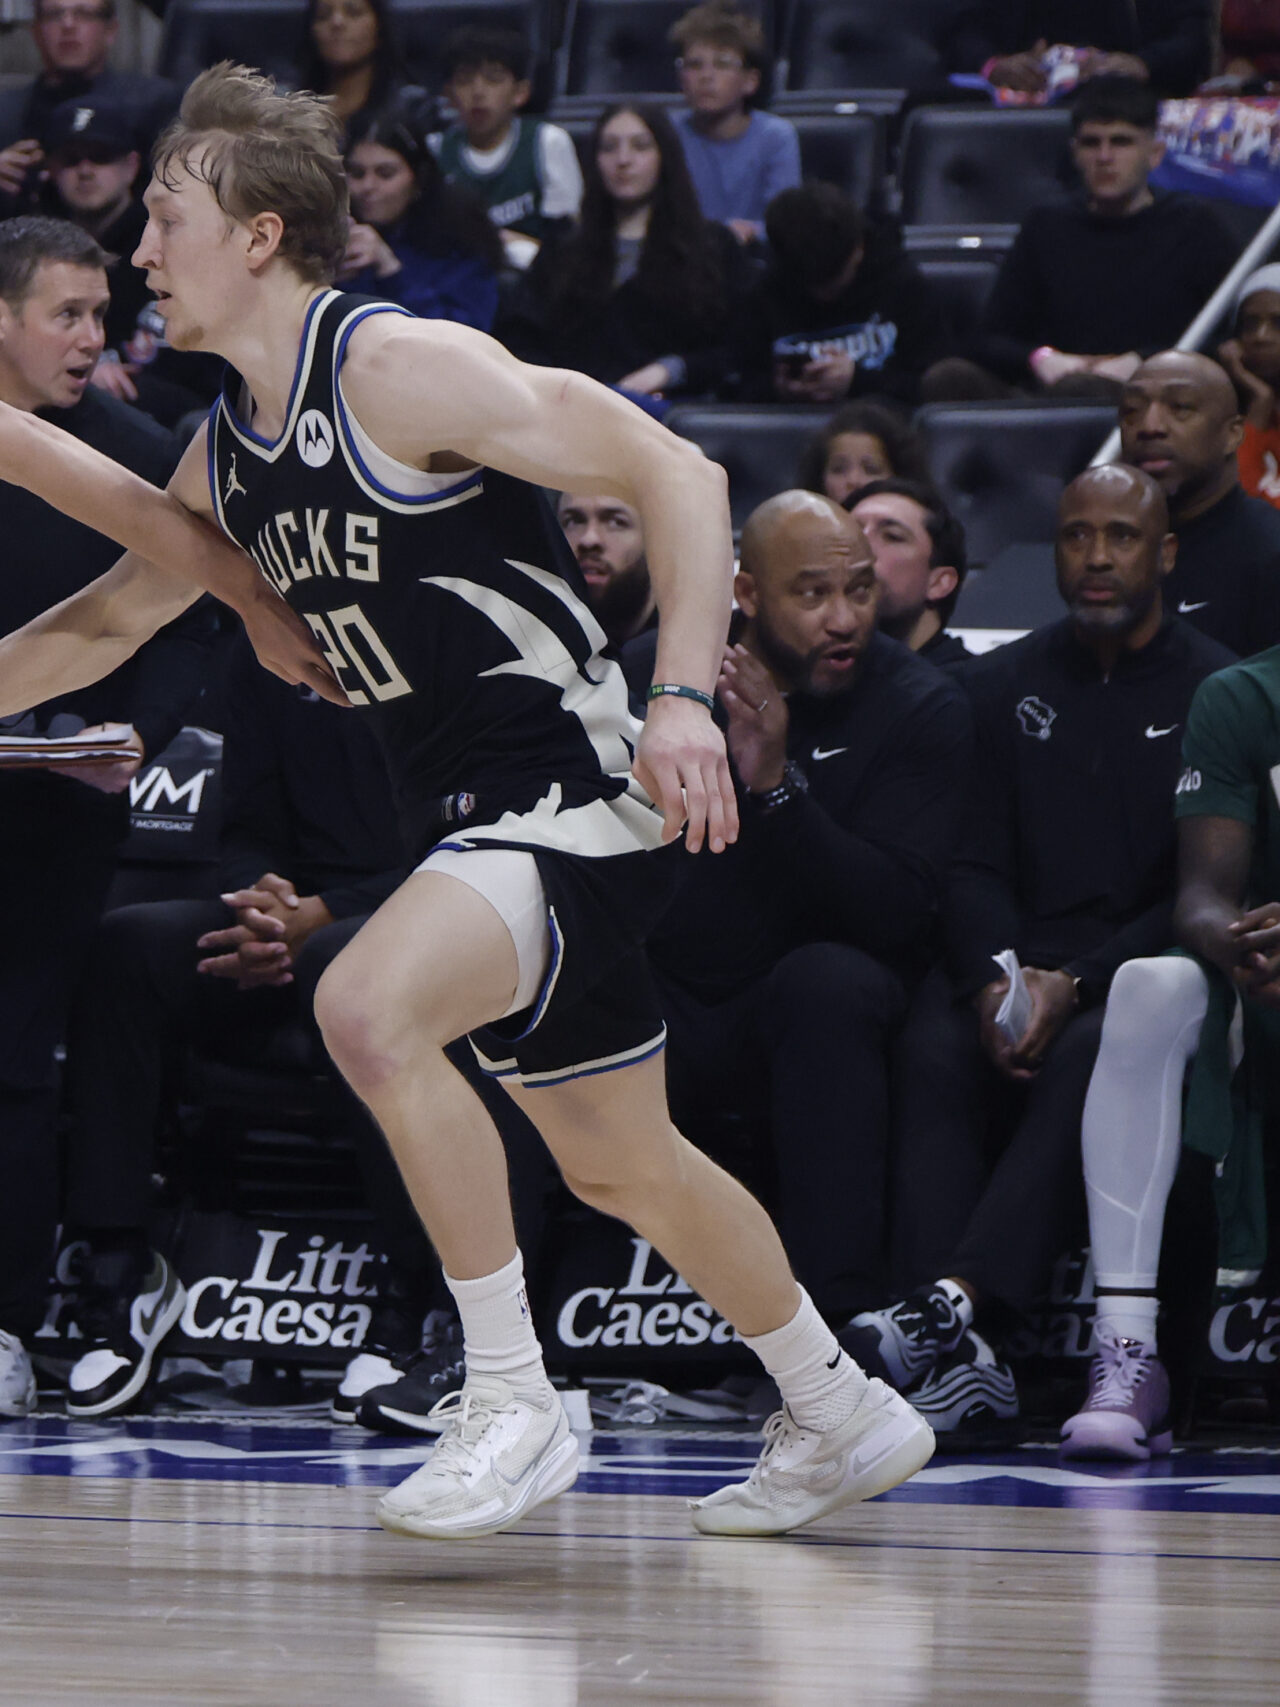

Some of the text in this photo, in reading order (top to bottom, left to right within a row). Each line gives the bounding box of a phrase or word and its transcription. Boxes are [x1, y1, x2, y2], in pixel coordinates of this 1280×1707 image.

[251, 507, 380, 601] UCKS
[302, 603, 413, 706] 20
[241, 1229, 389, 1296] Litt
[180, 1276, 372, 1347] Caesa
